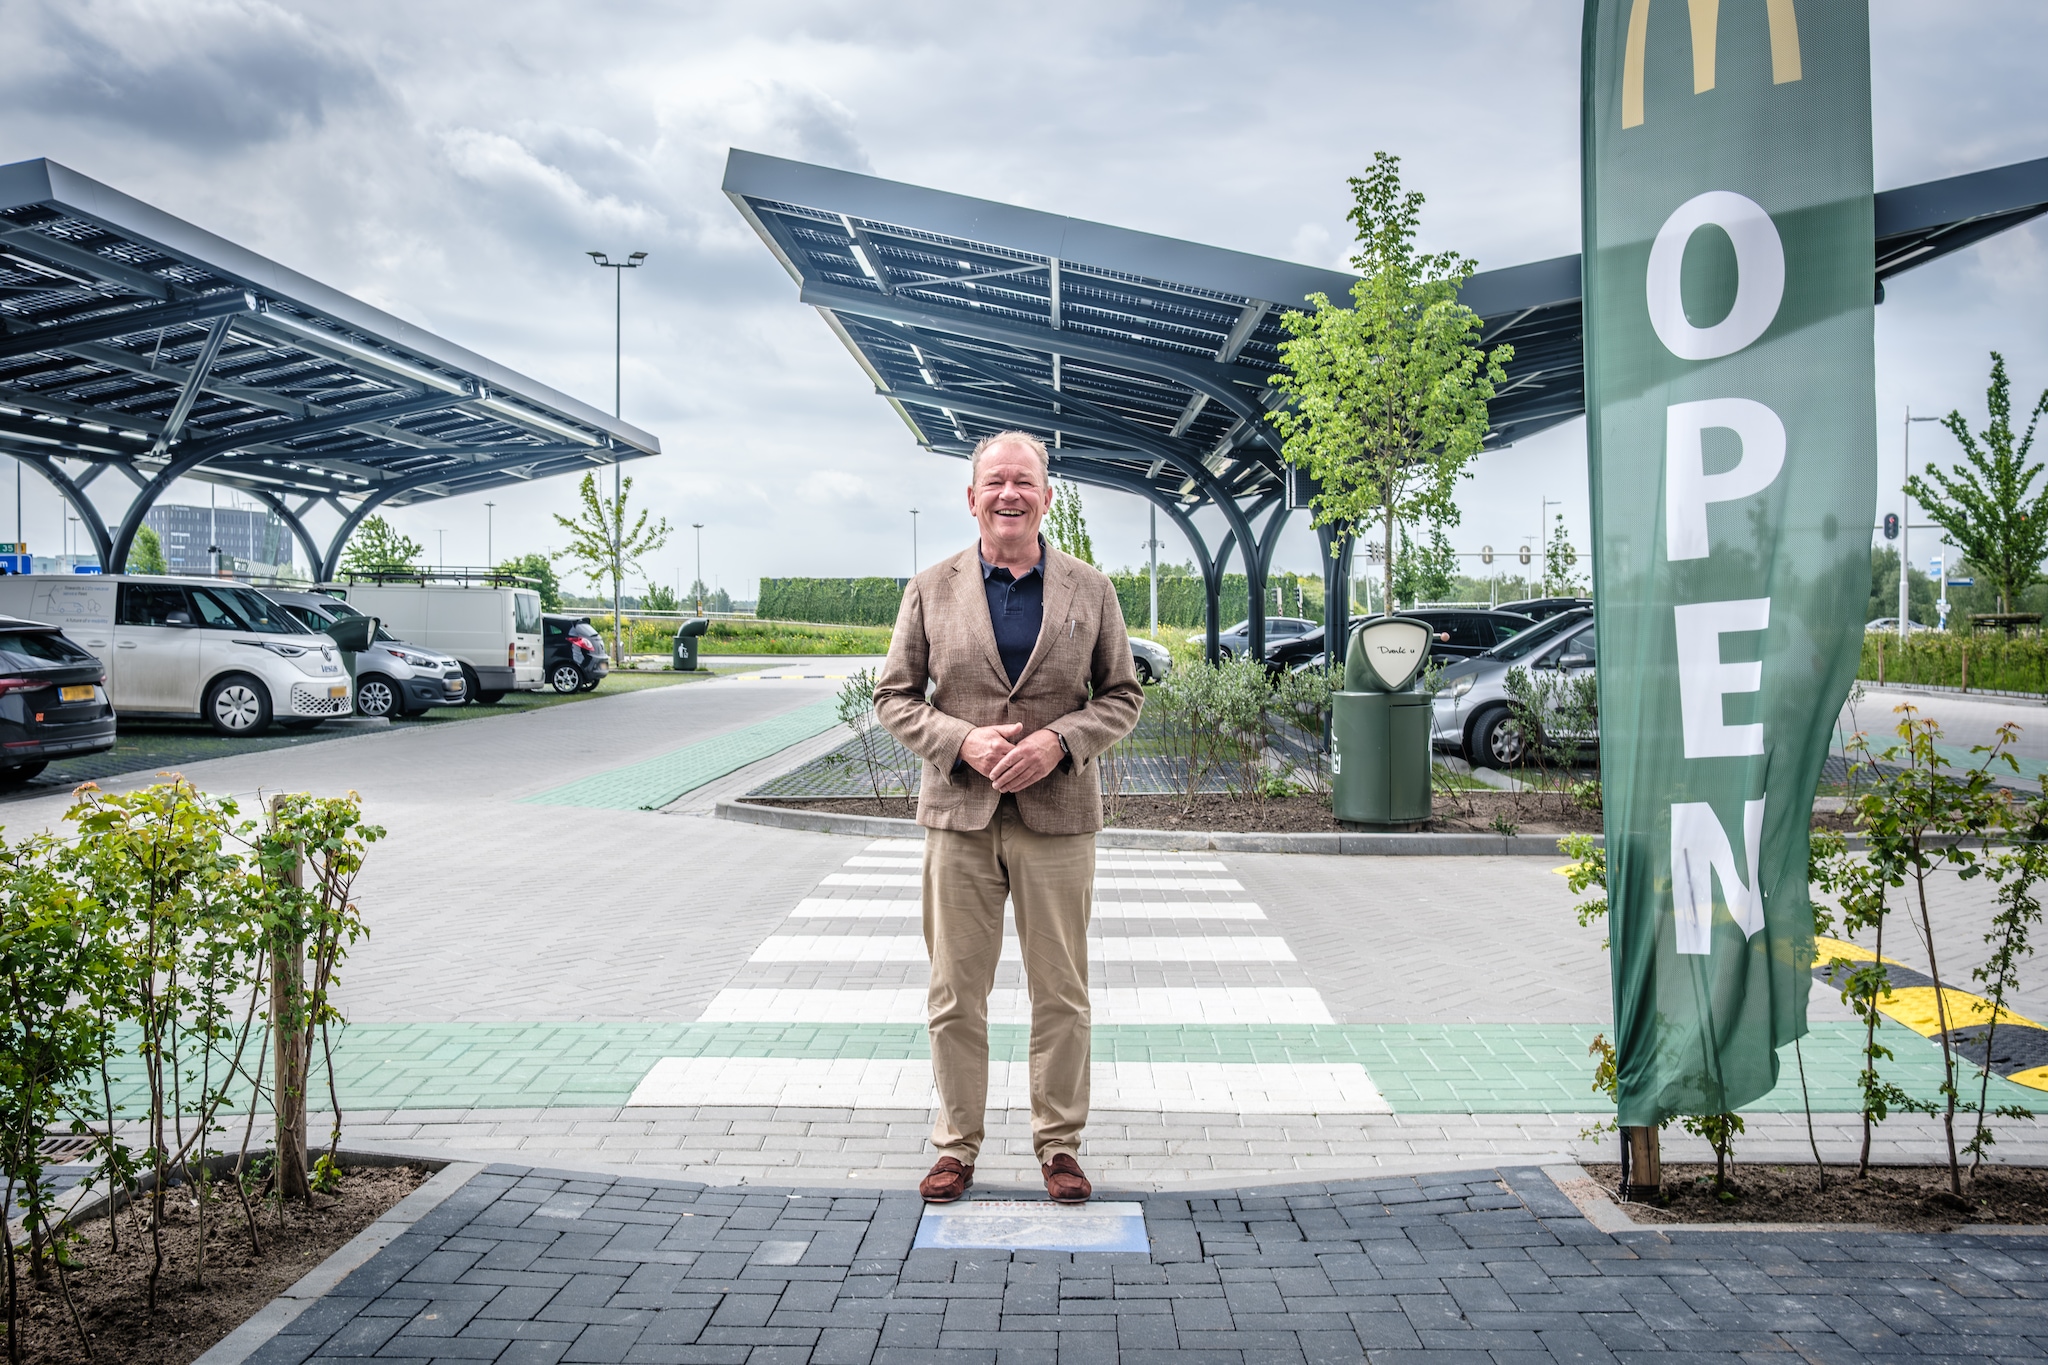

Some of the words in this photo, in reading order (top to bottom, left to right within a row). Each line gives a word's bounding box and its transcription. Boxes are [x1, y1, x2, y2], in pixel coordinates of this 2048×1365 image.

[2, 544, 14, 553] 35
[1646, 190, 1787, 955] OPEN
[1377, 645, 1406, 654] Dank
